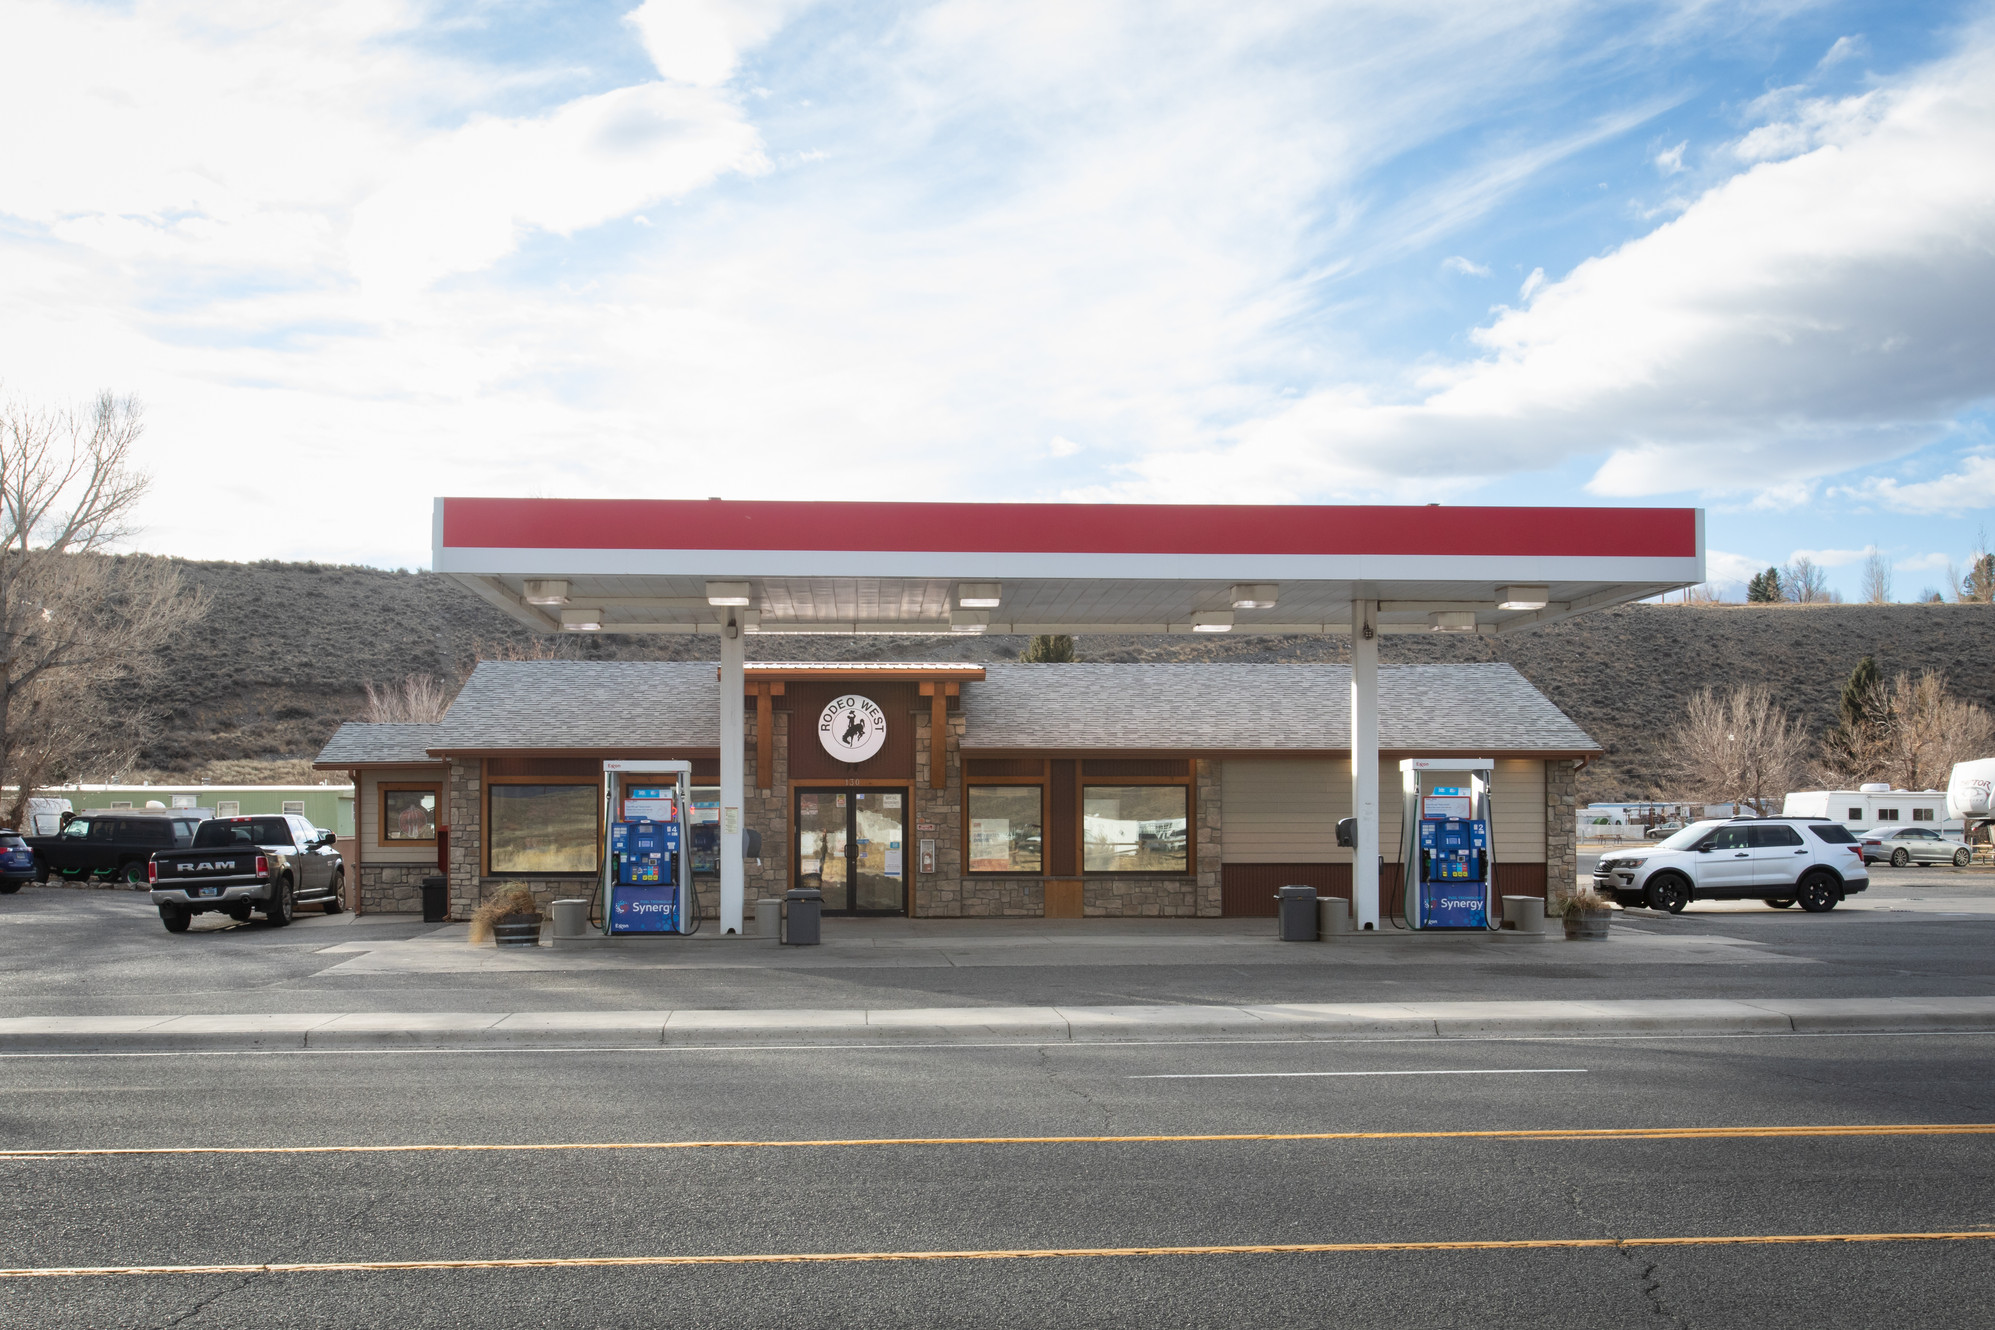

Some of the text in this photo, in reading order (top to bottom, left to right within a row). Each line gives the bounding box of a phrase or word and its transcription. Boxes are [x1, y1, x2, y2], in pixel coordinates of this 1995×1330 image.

[820, 697, 884, 732] RODEO WEST
[845, 778, 860, 786] 130
[177, 861, 235, 872] RAM
[632, 902, 676, 914] Synergy
[1440, 898, 1483, 910] Synergy
